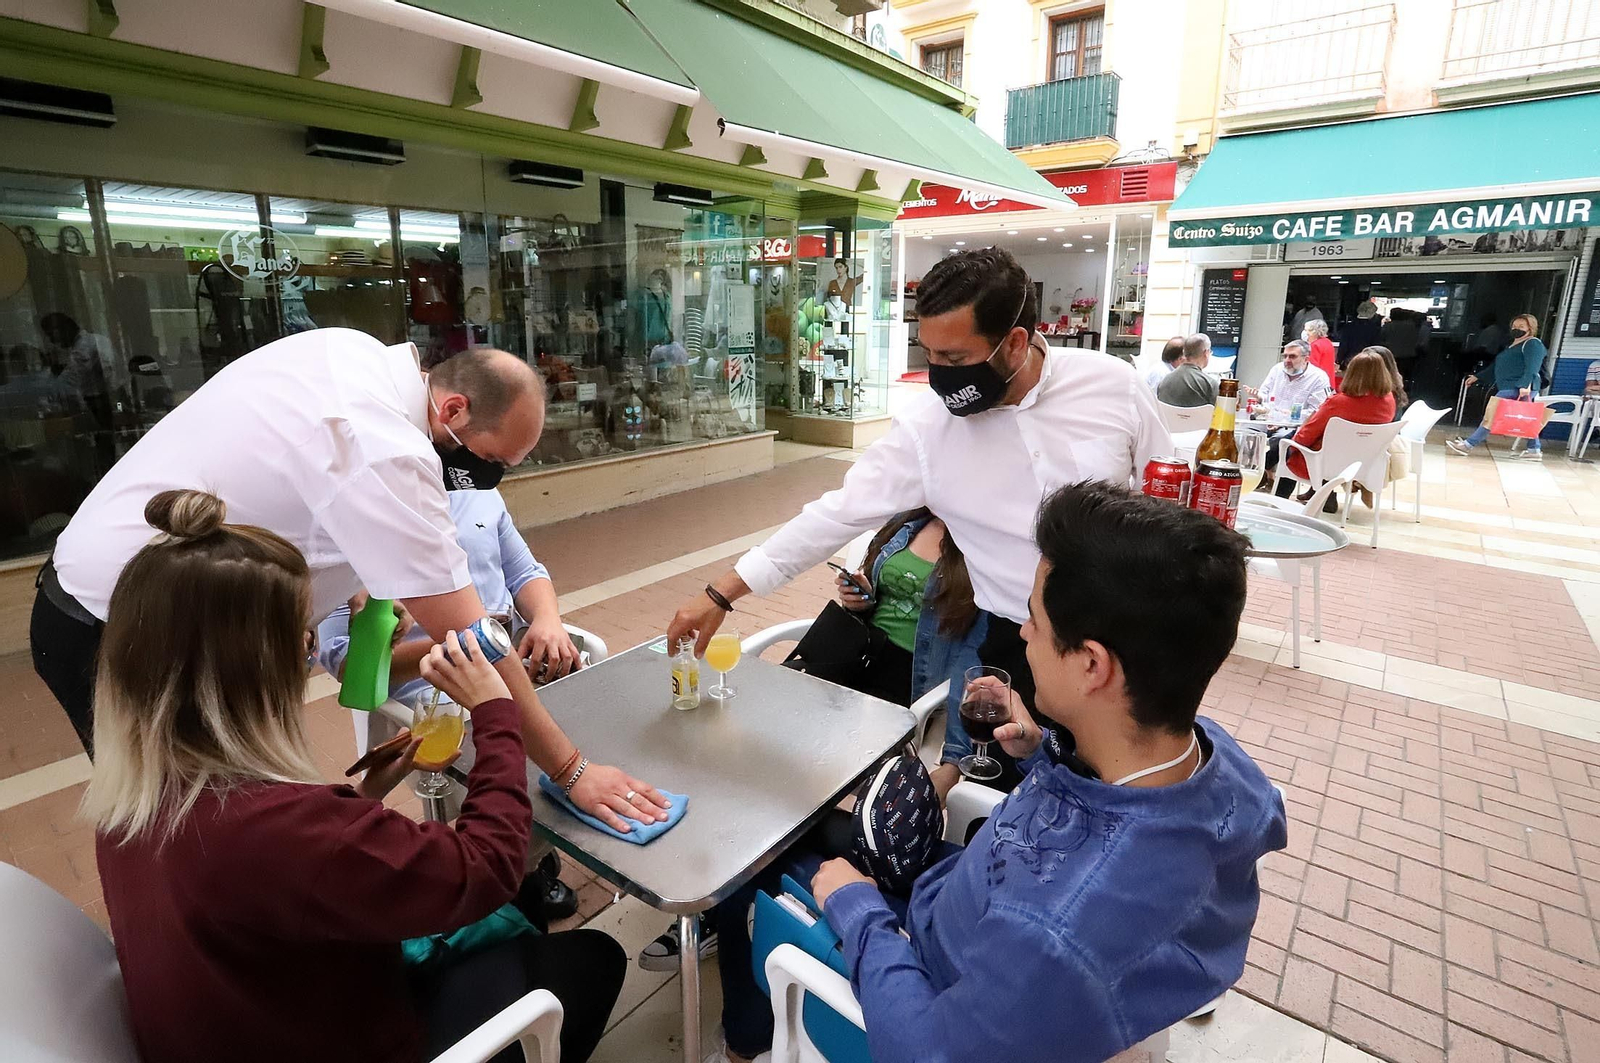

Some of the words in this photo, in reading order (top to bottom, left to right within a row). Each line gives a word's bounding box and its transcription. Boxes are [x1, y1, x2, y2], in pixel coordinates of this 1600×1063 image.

[1059, 184, 1087, 195] ZADOS
[1272, 215, 1343, 240] CAFE
[1354, 211, 1415, 235] BAR
[1428, 199, 1592, 232] AGMANIR
[1173, 226, 1216, 240] Centro
[1219, 222, 1264, 239] Suizo
[1311, 245, 1344, 256] 1963
[945, 384, 979, 404] ANIR
[454, 467, 477, 490] AGM
